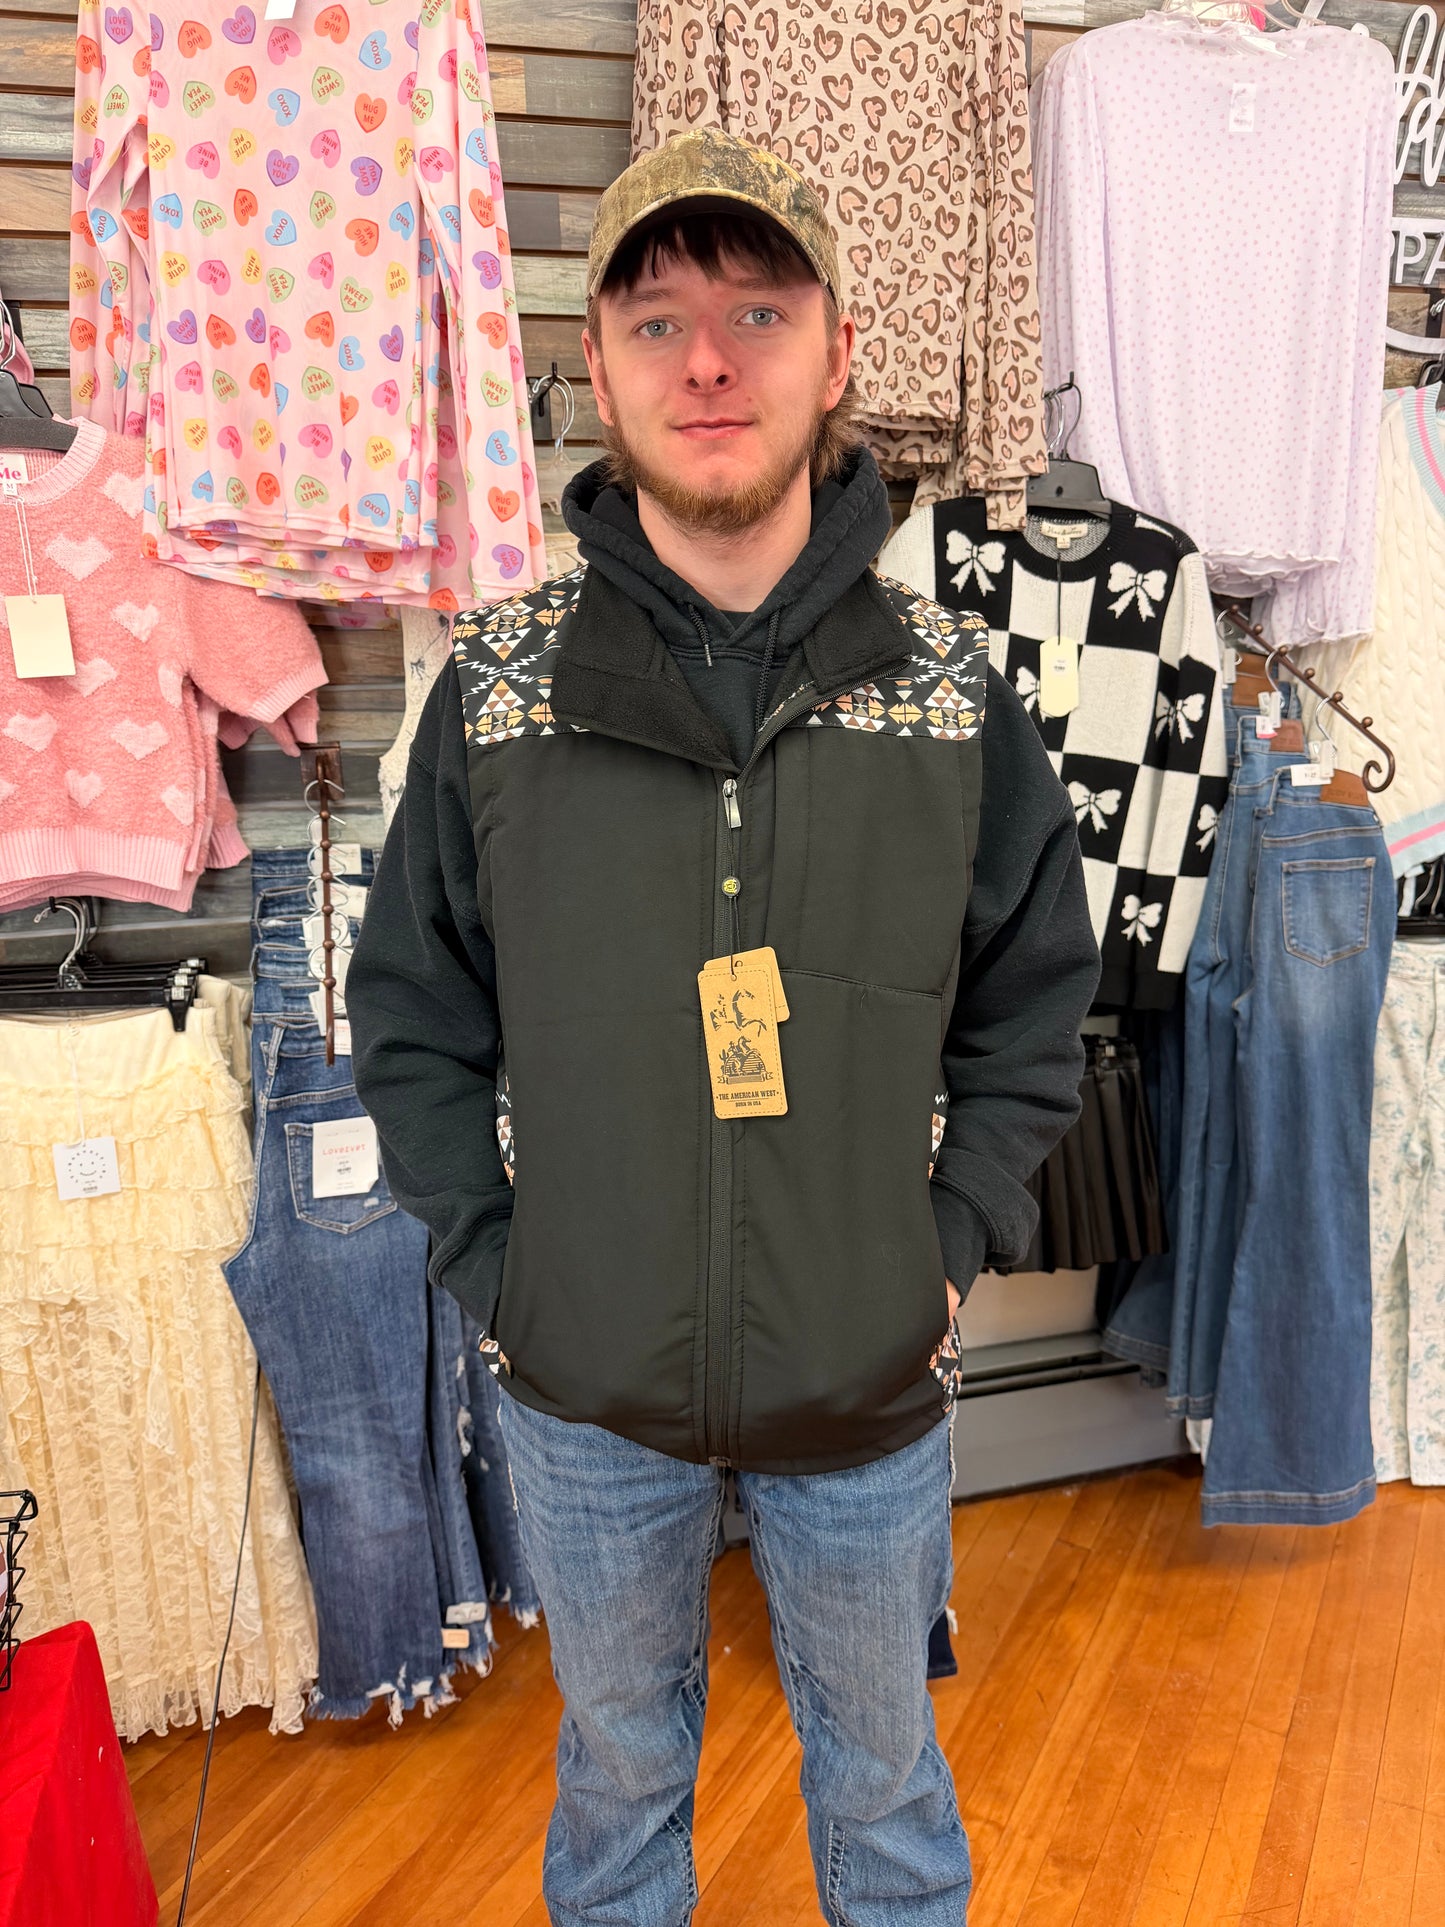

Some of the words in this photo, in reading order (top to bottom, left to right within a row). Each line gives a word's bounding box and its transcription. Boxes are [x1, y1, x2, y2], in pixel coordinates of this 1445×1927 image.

[110, 16, 127, 25] LOVE
[230, 15, 248, 33] LOVE
[330, 11, 343, 22] ME
[111, 27, 126, 36] YOU
[184, 26, 196, 38] ME
[237, 25, 252, 40] YOU
[324, 20, 341, 34] HUG
[187, 34, 204, 49] HUG
[271, 32, 291, 48] MINE
[81, 44, 92, 53] ME
[280, 44, 290, 54] BE
[370, 39, 382, 65] XOXO
[83, 53, 97, 65] HUG
[240, 72, 251, 84] ME
[316, 72, 332, 85] PEA
[187, 86, 202, 99] PEA
[233, 80, 249, 95] HUG
[317, 79, 340, 98] SWEET
[466, 82, 480, 97] PEA
[112, 92, 123, 100] PEA
[190, 92, 211, 112] SWEET
[416, 93, 430, 108] PEA
[107, 102, 125, 111] SWEET
[363, 103, 379, 115] HUG
[81, 105, 97, 125] CUTIE
[363, 114, 375, 125] ME
[150, 139, 160, 150] PIE
[234, 134, 245, 146] PIE
[321, 134, 338, 150] MINE
[152, 144, 171, 163] CUTIE
[198, 146, 216, 161] MINE
[234, 141, 252, 158] CUTIE
[322, 146, 330, 156] BE
[399, 144, 408, 157] PIE
[475, 136, 489, 163] XOXO
[200, 158, 209, 168] BE
[273, 158, 291, 171] LOVE
[422, 149, 440, 168] MINE
[433, 160, 444, 171] BE
[272, 168, 288, 180] YOU
[358, 166, 370, 187] LOVE
[369, 165, 377, 183] YOU
[239, 195, 248, 206] ME
[314, 196, 327, 209] PEA
[478, 199, 492, 211] HUG
[198, 207, 213, 218] PEA
[241, 202, 253, 217] HUG
[315, 202, 333, 222] SWEET
[480, 210, 490, 221] ME
[200, 212, 223, 230] SWEET
[273, 218, 288, 241] XOXO
[364, 226, 375, 240] ME
[355, 229, 369, 247] HUG
[166, 258, 179, 269] PIE
[208, 262, 226, 279] MINE
[246, 256, 256, 278] CUTIE
[320, 256, 332, 271] MINE
[480, 260, 492, 280] LOVE
[490, 259, 498, 277] YOU
[76, 270, 88, 280] PIE
[112, 266, 124, 281] PEA
[168, 263, 186, 280] CUTIE
[253, 264, 261, 279] PIE
[320, 268, 328, 279] BE
[390, 270, 401, 280] PIE
[76, 279, 95, 290] CUTIE
[210, 274, 218, 285] BE
[269, 273, 283, 299] SWEET
[279, 274, 289, 291] PEA
[390, 277, 406, 292] CUTIE
[344, 283, 369, 304] SWEET
[344, 294, 357, 309] PEA
[76, 324, 88, 333] ME
[176, 318, 190, 335] LOVE
[320, 318, 331, 329] ME
[494, 318, 504, 332] ME
[79, 331, 94, 344] HUG
[183, 326, 197, 341] YOU
[314, 326, 330, 339] HUG
[486, 322, 500, 341] HUG
[344, 343, 355, 366] XOXO
[308, 373, 322, 383] PEA
[307, 378, 331, 395] SWEET
[485, 378, 508, 396] SWEET
[486, 389, 500, 403] PEA
[190, 424, 201, 435] PIE
[192, 426, 207, 446] CUTIE
[310, 426, 330, 443] MINE
[310, 438, 321, 448] BE
[372, 441, 384, 453] PIE
[493, 438, 508, 461] XOXO
[372, 449, 392, 464] CUTIE
[300, 481, 315, 492] PEA
[300, 488, 325, 503] SWEET
[496, 496, 511, 506] HUG
[364, 500, 385, 518] XOXO
[498, 506, 508, 515] ME
[500, 552, 512, 571] LOVE
[508, 551, 519, 567] YOU
[730, 1091, 760, 1100] AMERICAN
